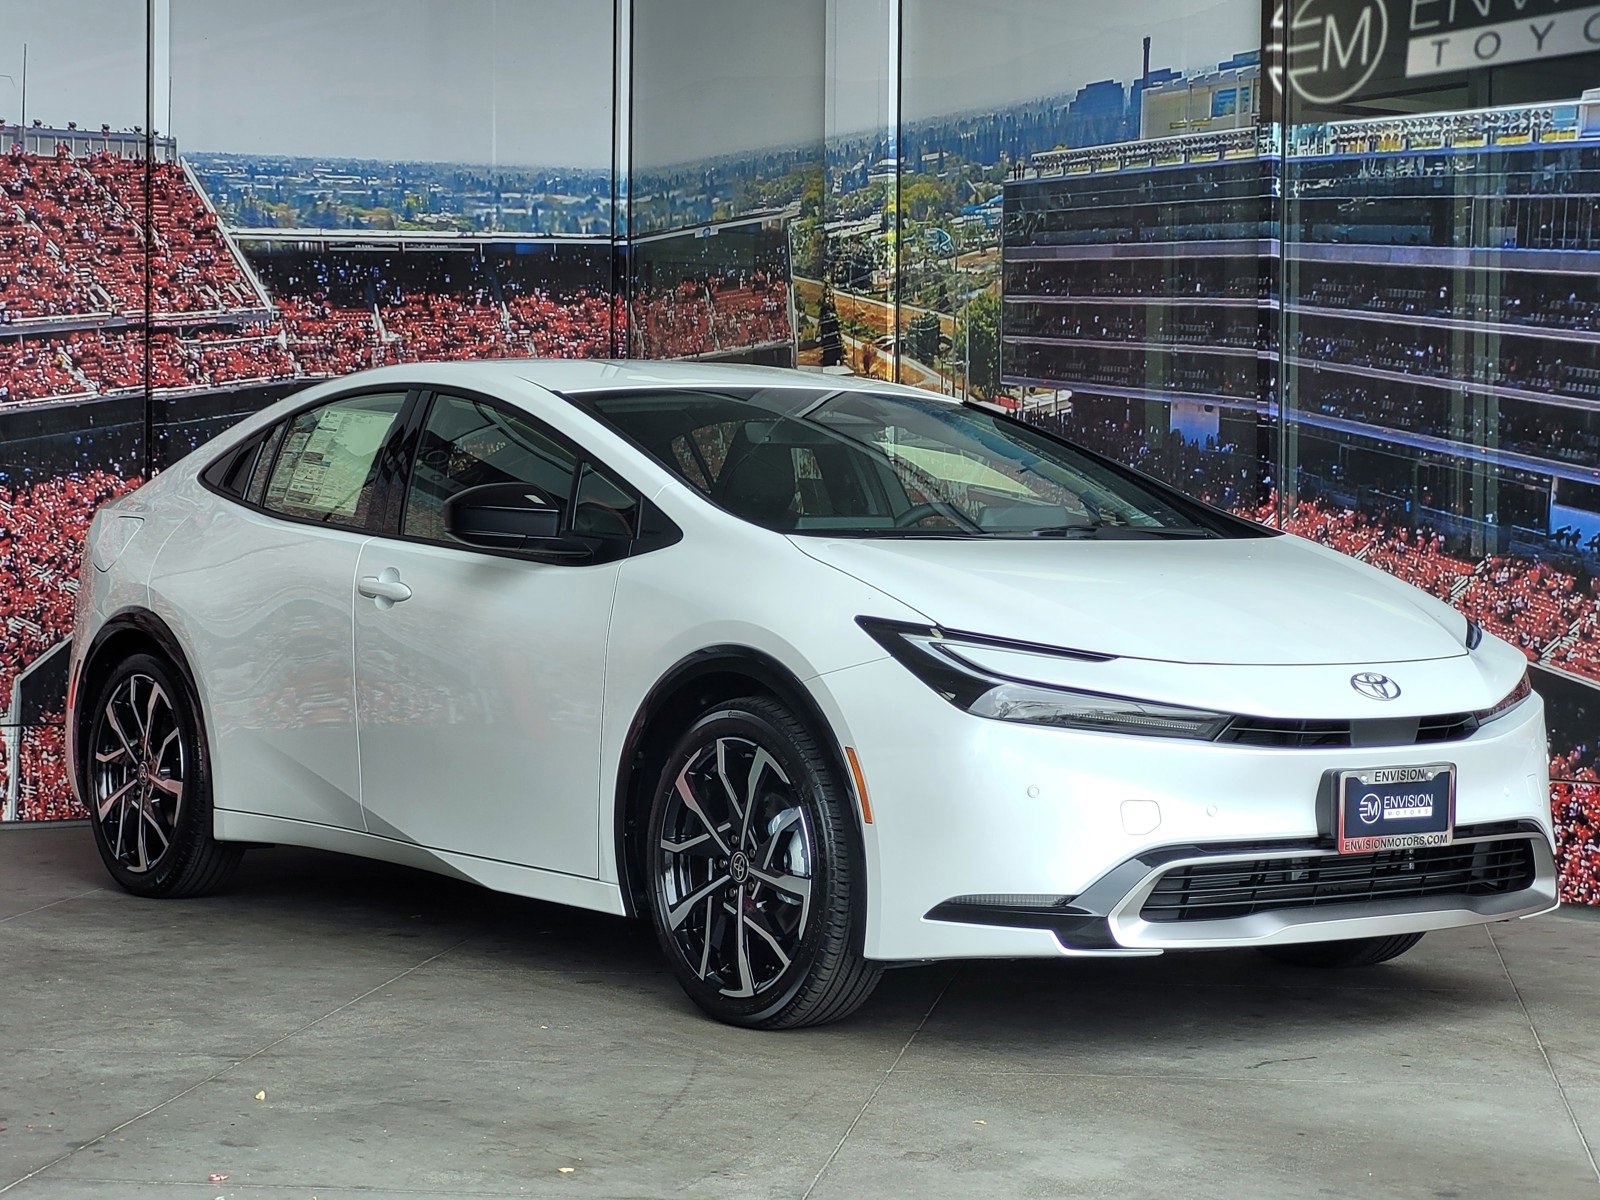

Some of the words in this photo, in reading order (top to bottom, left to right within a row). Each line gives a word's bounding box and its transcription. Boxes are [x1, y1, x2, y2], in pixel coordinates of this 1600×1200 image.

[1375, 769, 1424, 782] ENVISION
[1384, 794, 1433, 808] ENVISION
[1345, 834, 1447, 851] ENVISIONMOTORS.COM
